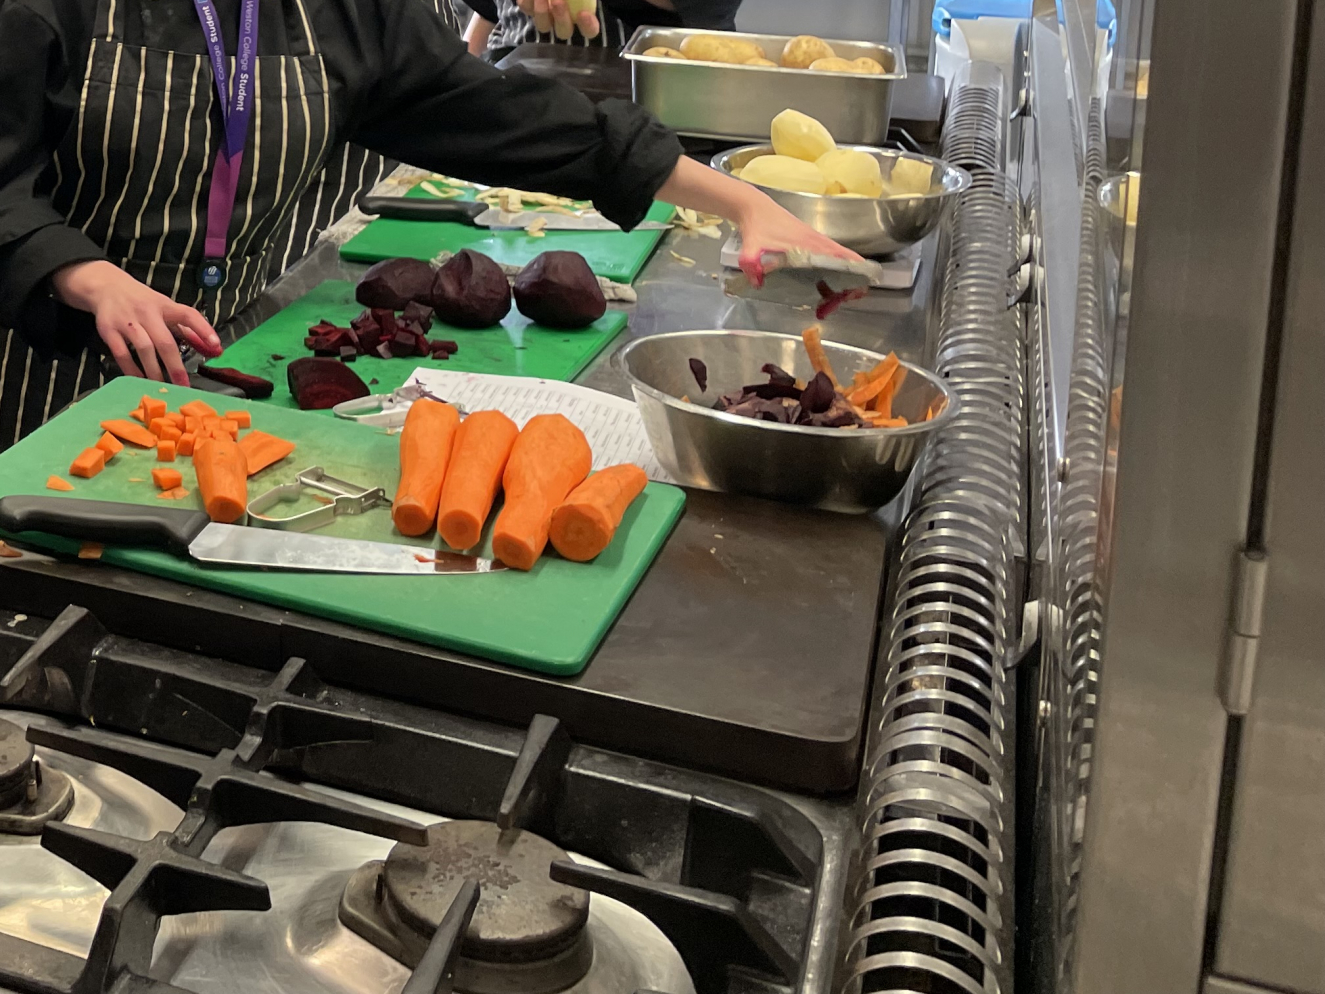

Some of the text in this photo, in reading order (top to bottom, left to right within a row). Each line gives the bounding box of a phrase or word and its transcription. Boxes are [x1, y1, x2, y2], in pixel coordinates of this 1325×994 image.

[202, 5, 218, 43] Student
[213, 44, 225, 81] College
[235, 0, 255, 112] Weston College Student
